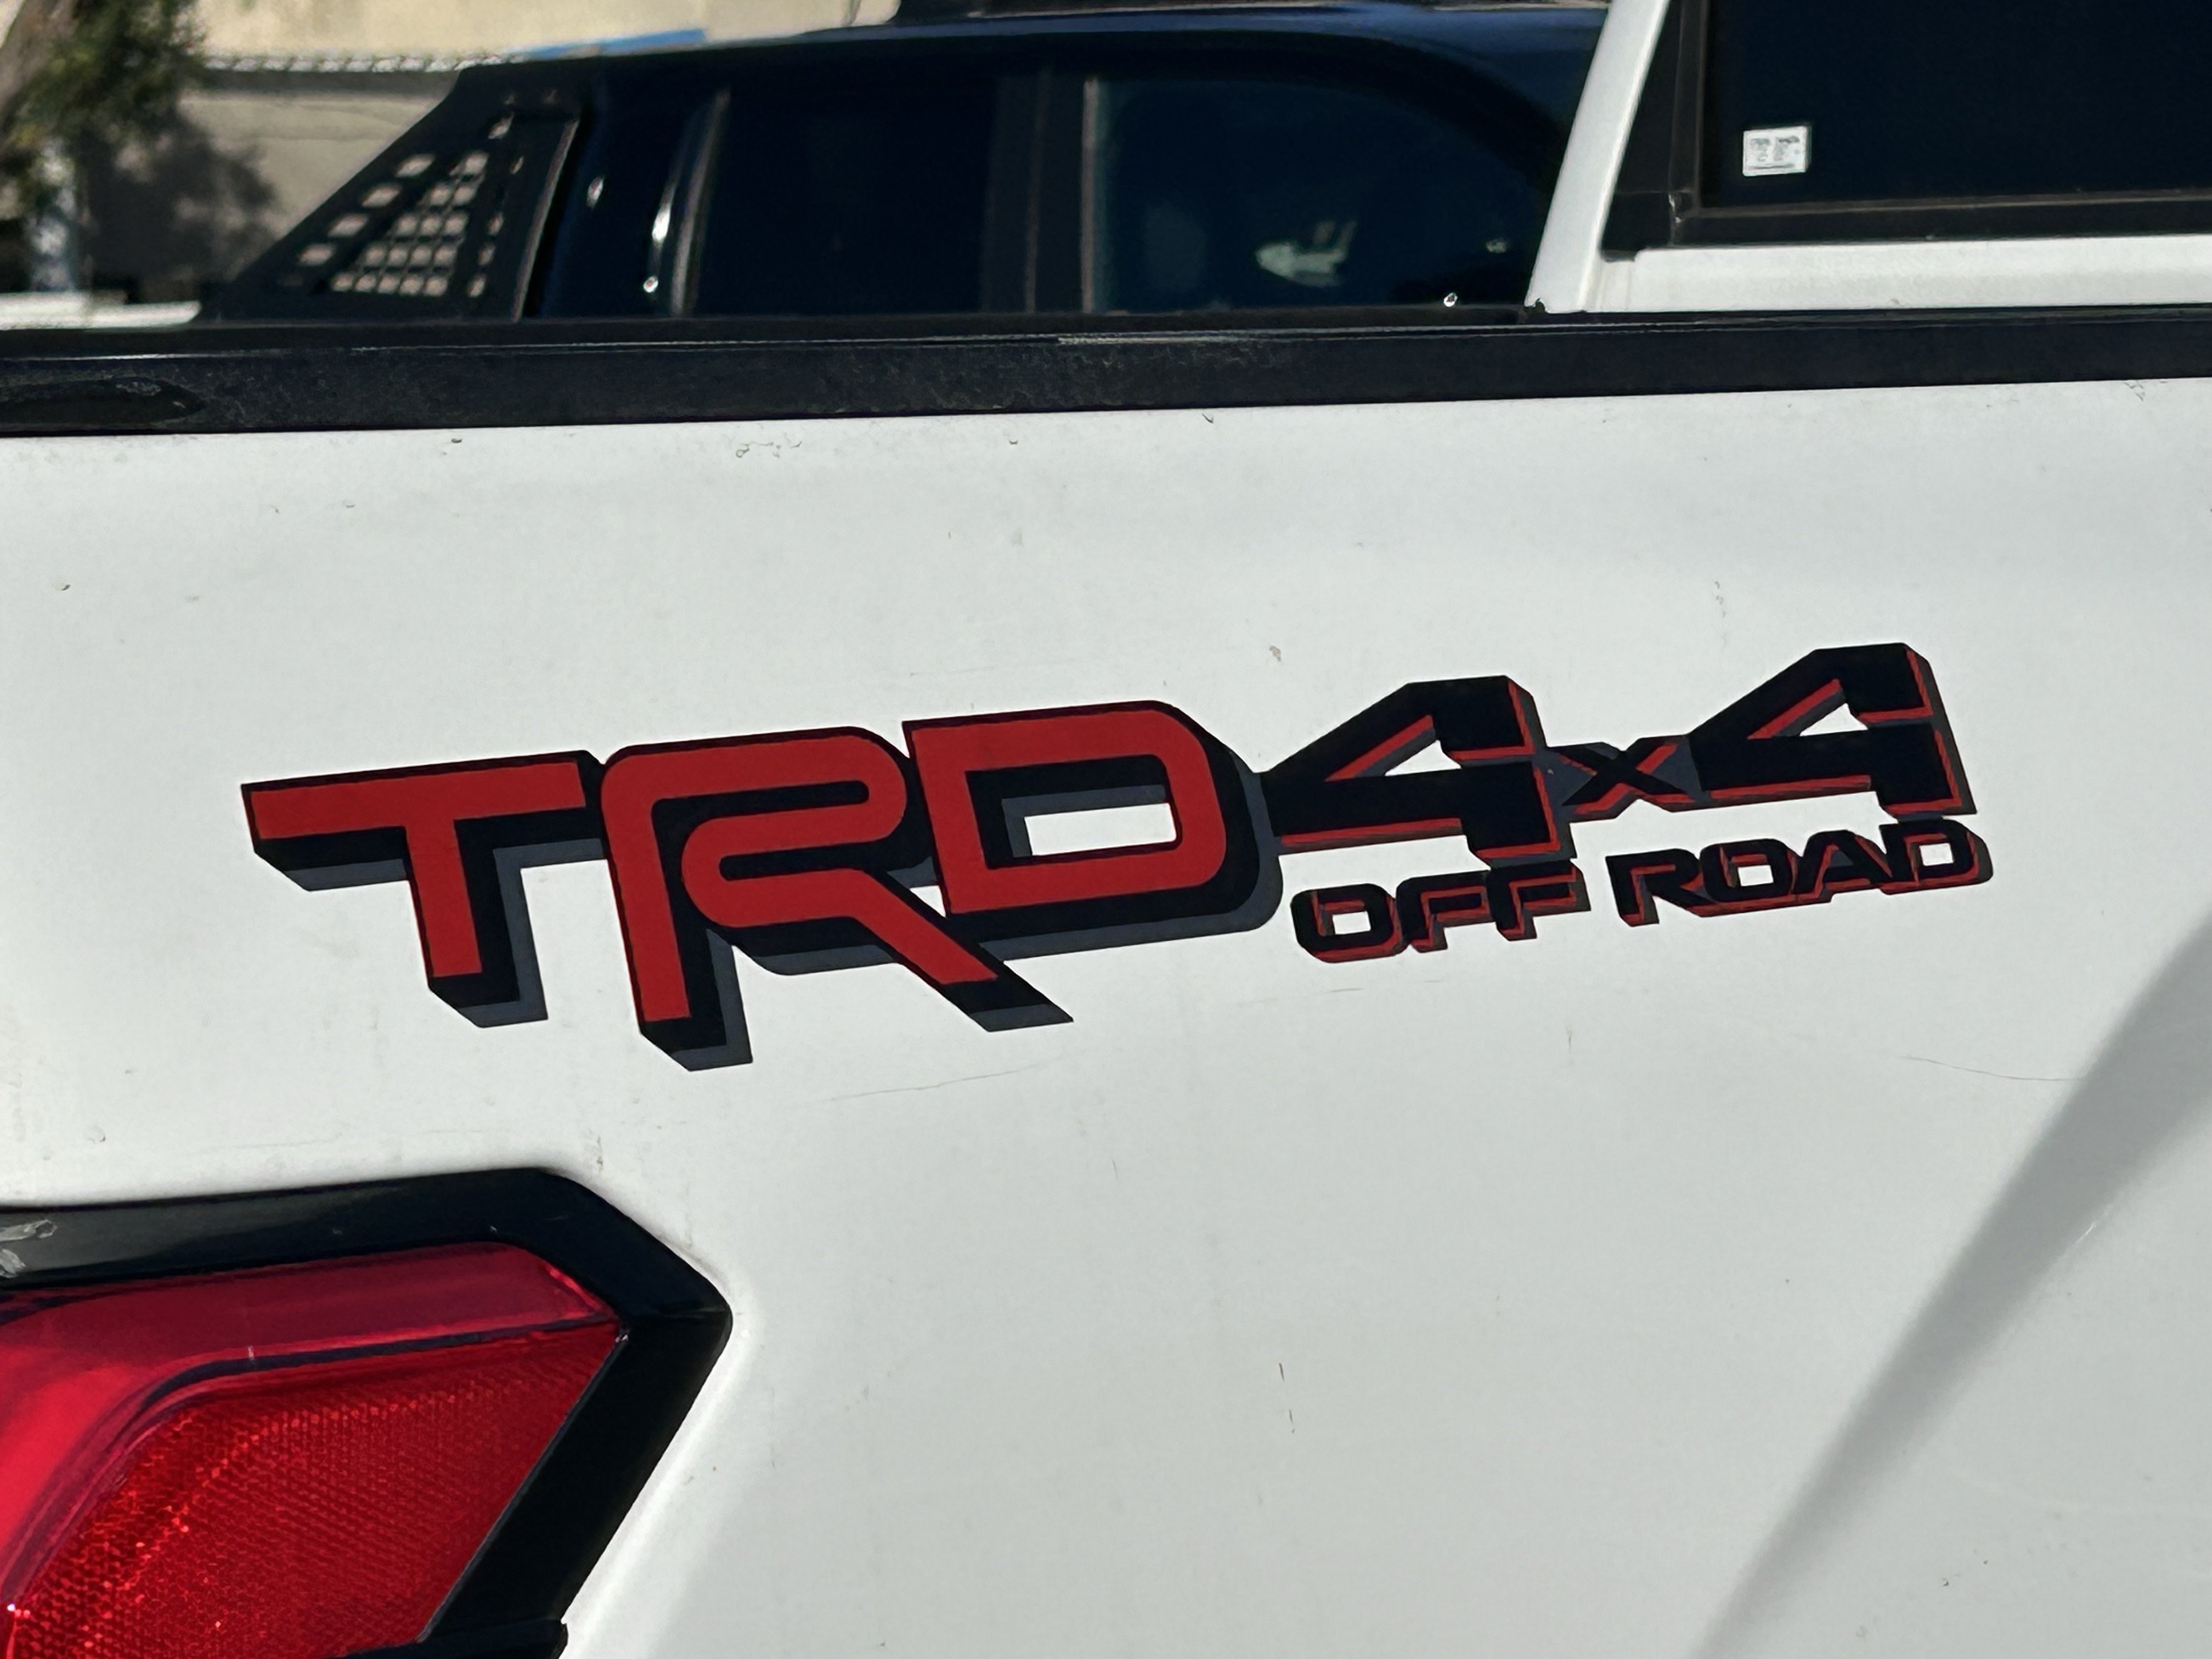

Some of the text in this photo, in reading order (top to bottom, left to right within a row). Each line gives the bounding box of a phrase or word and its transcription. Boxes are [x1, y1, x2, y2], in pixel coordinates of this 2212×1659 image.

[240, 701, 1283, 1071] TRD
[1290, 819, 1993, 963] OFF ROAD
